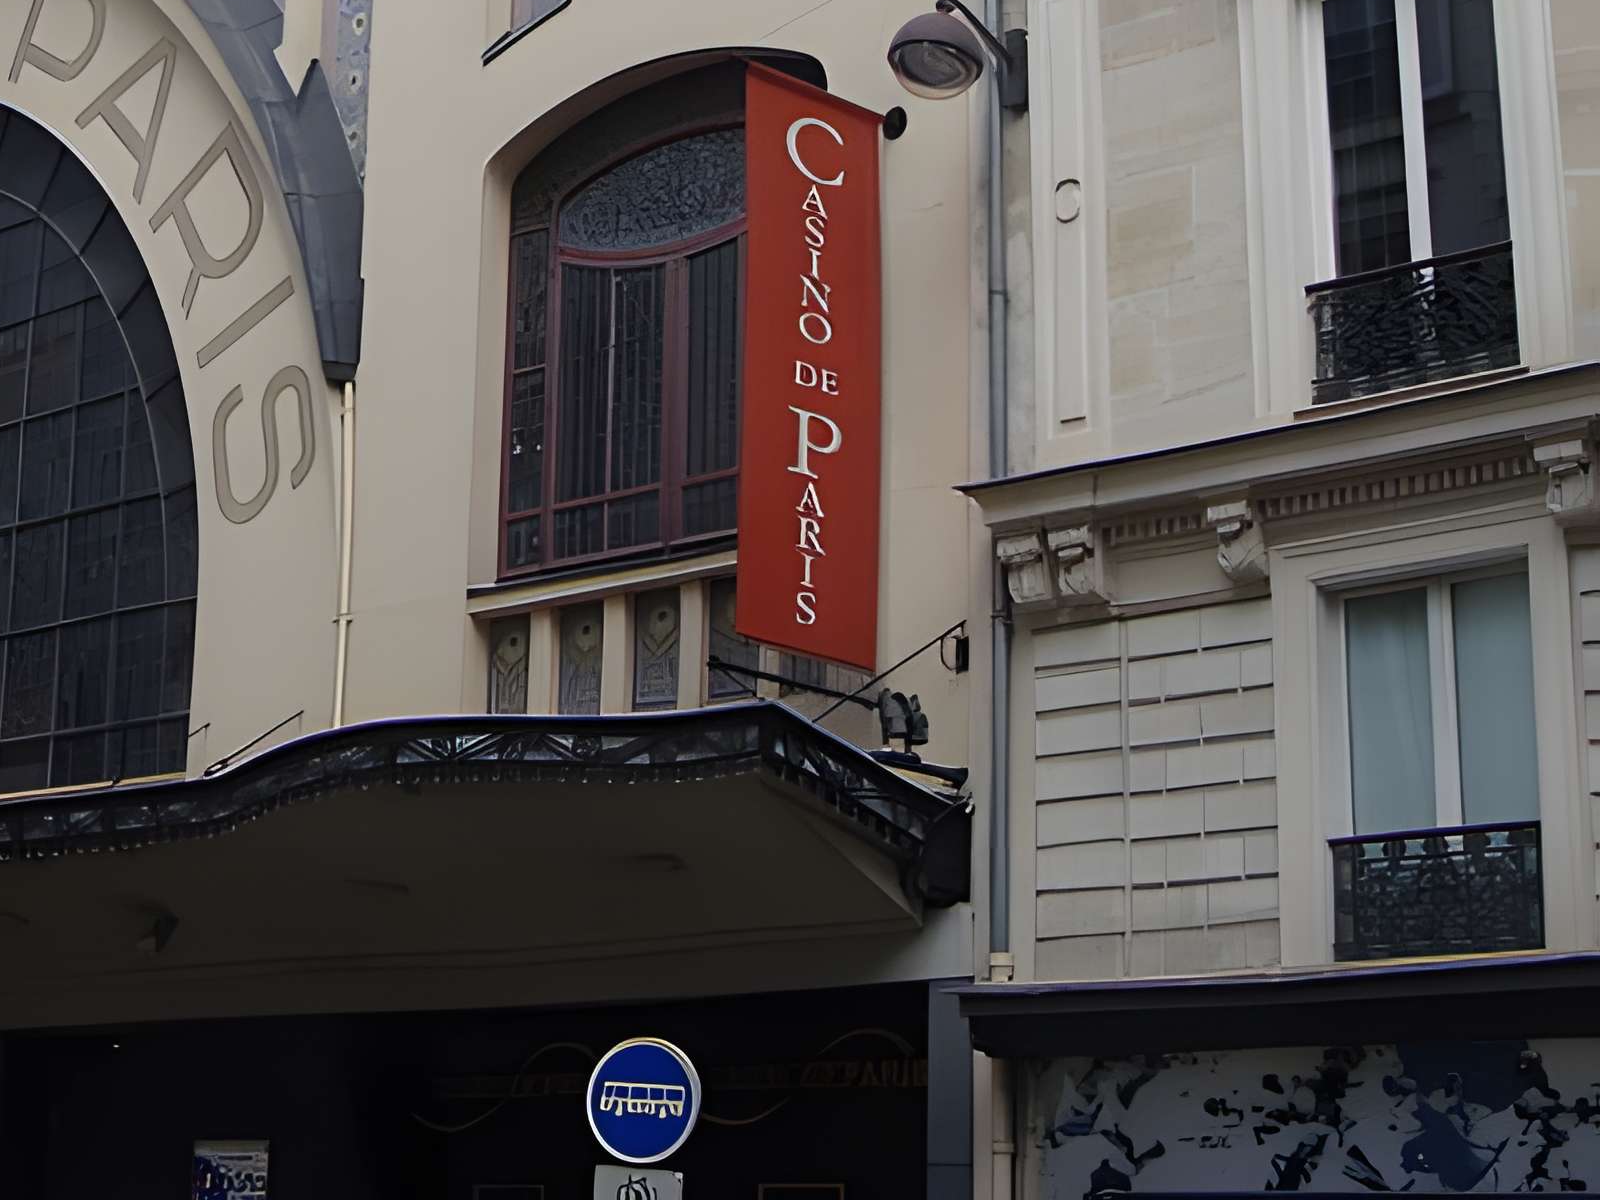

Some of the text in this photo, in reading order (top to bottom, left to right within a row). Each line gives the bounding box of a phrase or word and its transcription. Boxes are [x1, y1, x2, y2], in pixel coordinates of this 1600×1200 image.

[786, 117, 845, 626] CASINO DE PARIS
